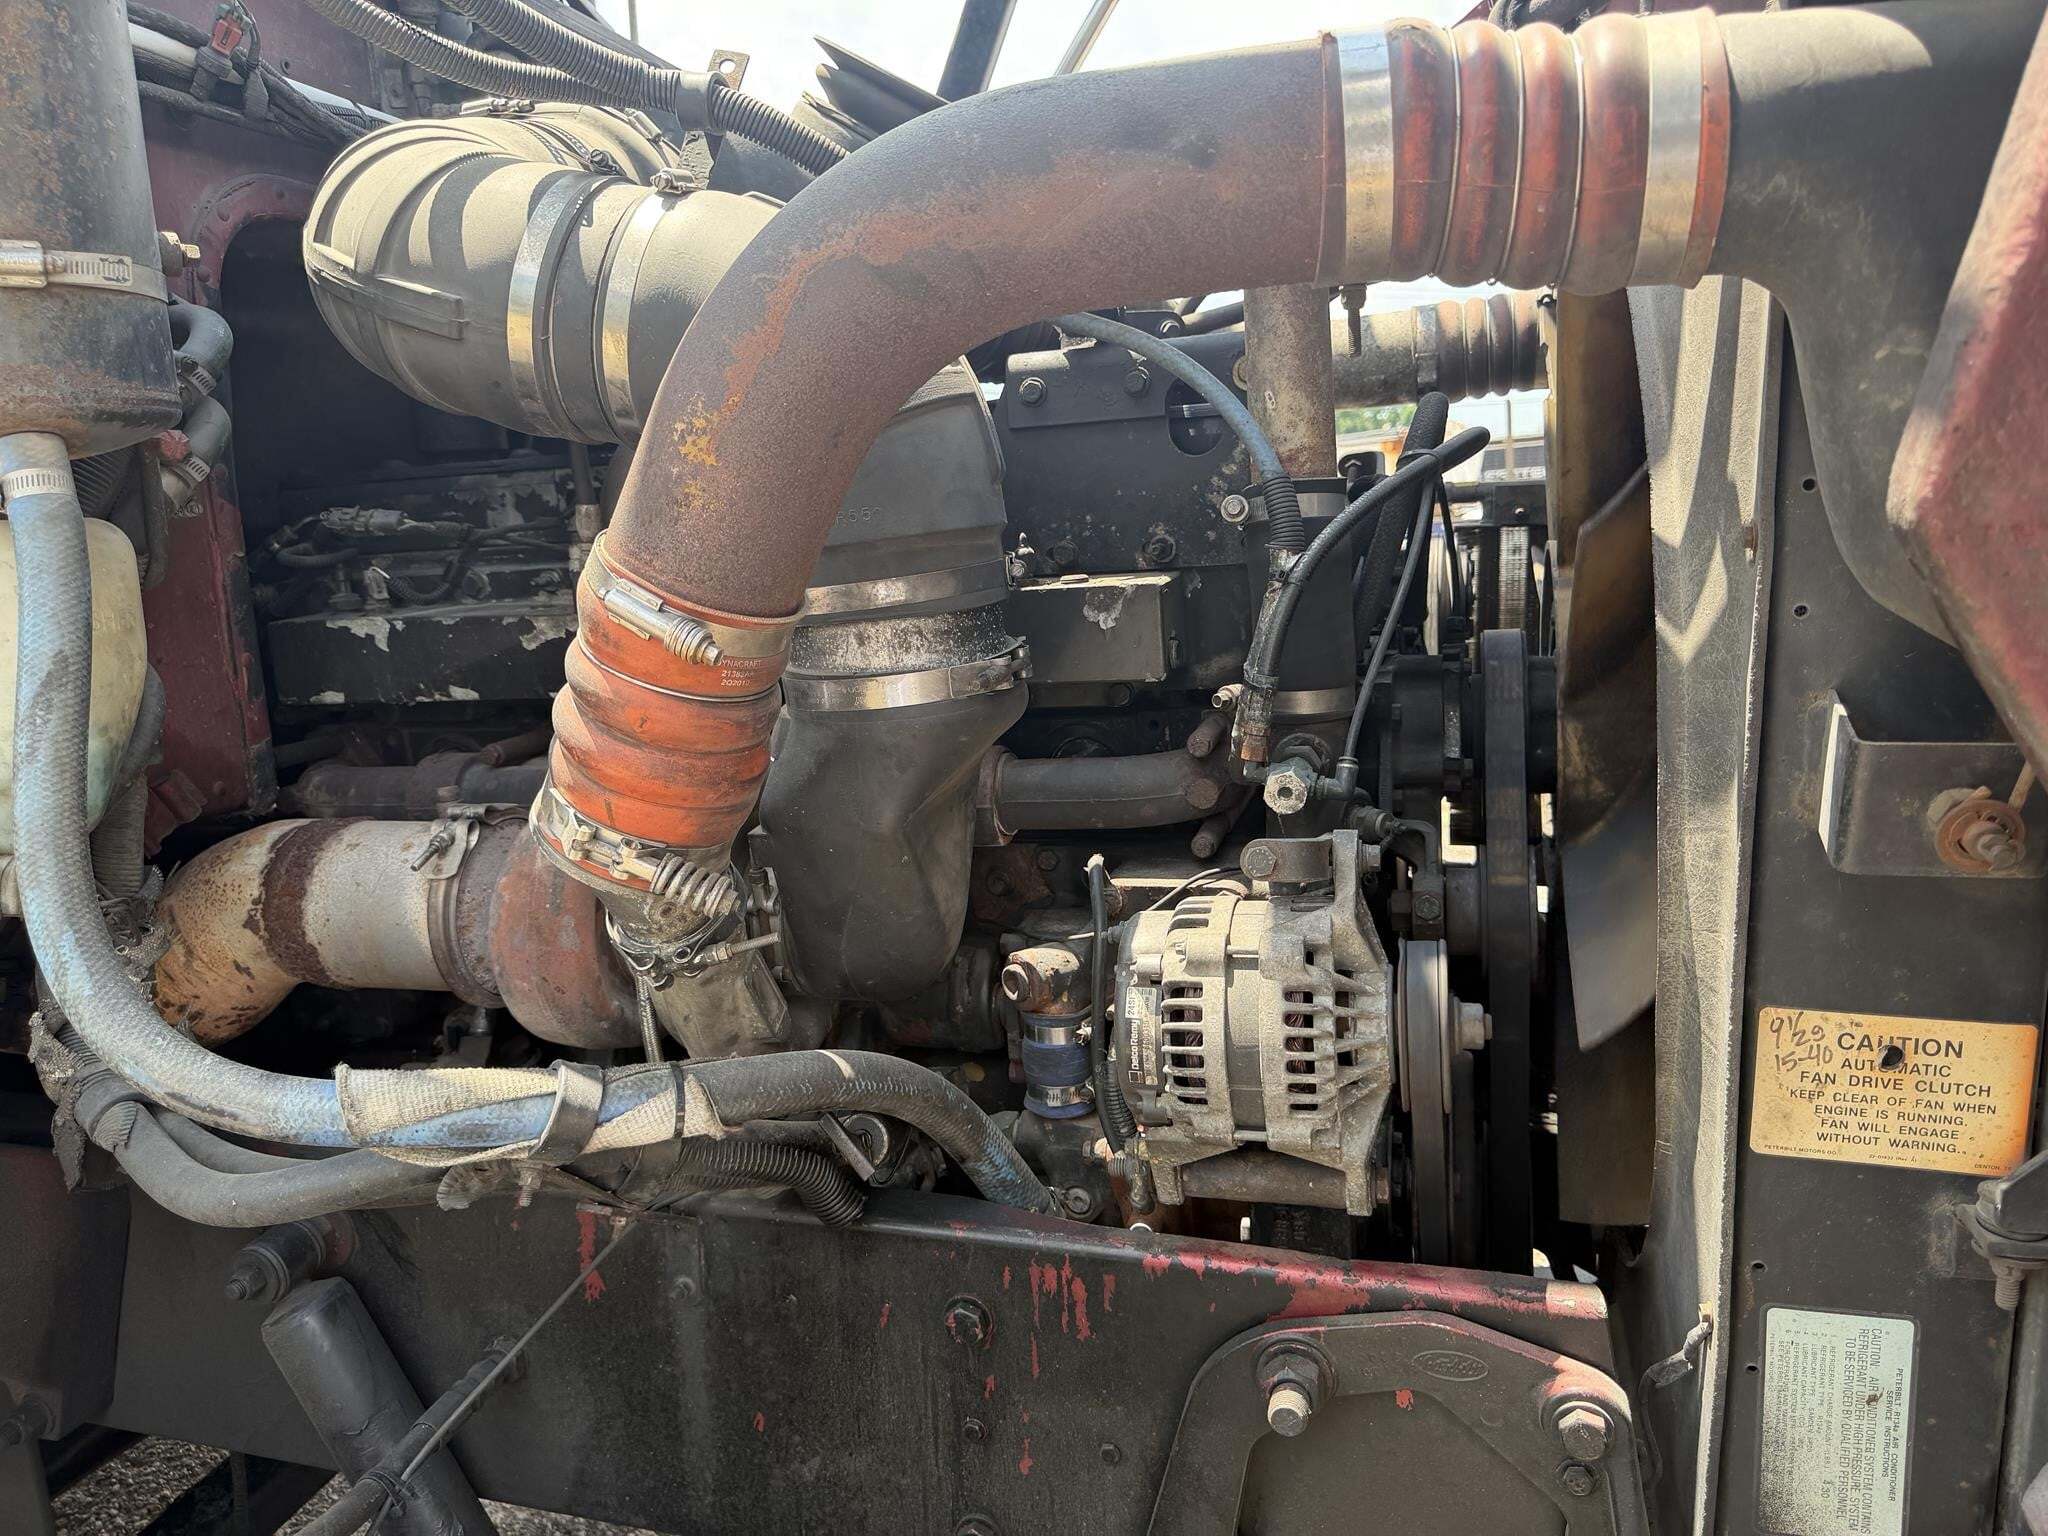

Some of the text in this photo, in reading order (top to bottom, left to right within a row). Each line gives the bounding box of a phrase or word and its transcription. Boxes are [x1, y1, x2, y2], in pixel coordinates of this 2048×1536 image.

[720, 659, 761, 669] YNACRAFT
[1800, 1071, 1992, 1098] FAN DRIVE CLUTCH
[1841, 1058, 1952, 1078] AUTMATIC
[1790, 1088, 1997, 1115] KEEP CLEAR OF FAN WHEN
[1815, 1105, 1968, 1127] ENGINE IS RUNNING.
[1817, 1132, 1962, 1155] WITHOUT WARNING.
[1821, 1119, 1960, 1140] FAN WILL ENGAGE
[1817, 1344, 1827, 1389] REFRIGERANT
[1826, 1345, 1836, 1391] REFRIGERANT
[1855, 1327, 1870, 1389] REFRIGERANT
[1867, 1375, 1879, 1392] AIR
[1893, 1367, 1903, 1406] PETERBILT
[1853, 1390, 1866, 1421] UNDER
[1835, 1336, 1856, 1520] TO BE SERVICED BY QUALIFIED PERSONNEL
[1852, 1422, 1864, 1445] HIGH
[1864, 1393, 1878, 1453] ONDITIONER
[1881, 1389, 1893, 1478] SERVICE INSTRUCTIONS
[1891, 1436, 1899, 1448] AIR
[1861, 1455, 1875, 1491] SYSTEM
[1888, 1453, 1898, 1502] CONDITIONER
[1847, 1496, 1860, 1531] SYSTEM
[1859, 1492, 1872, 1534] CONTAINS
